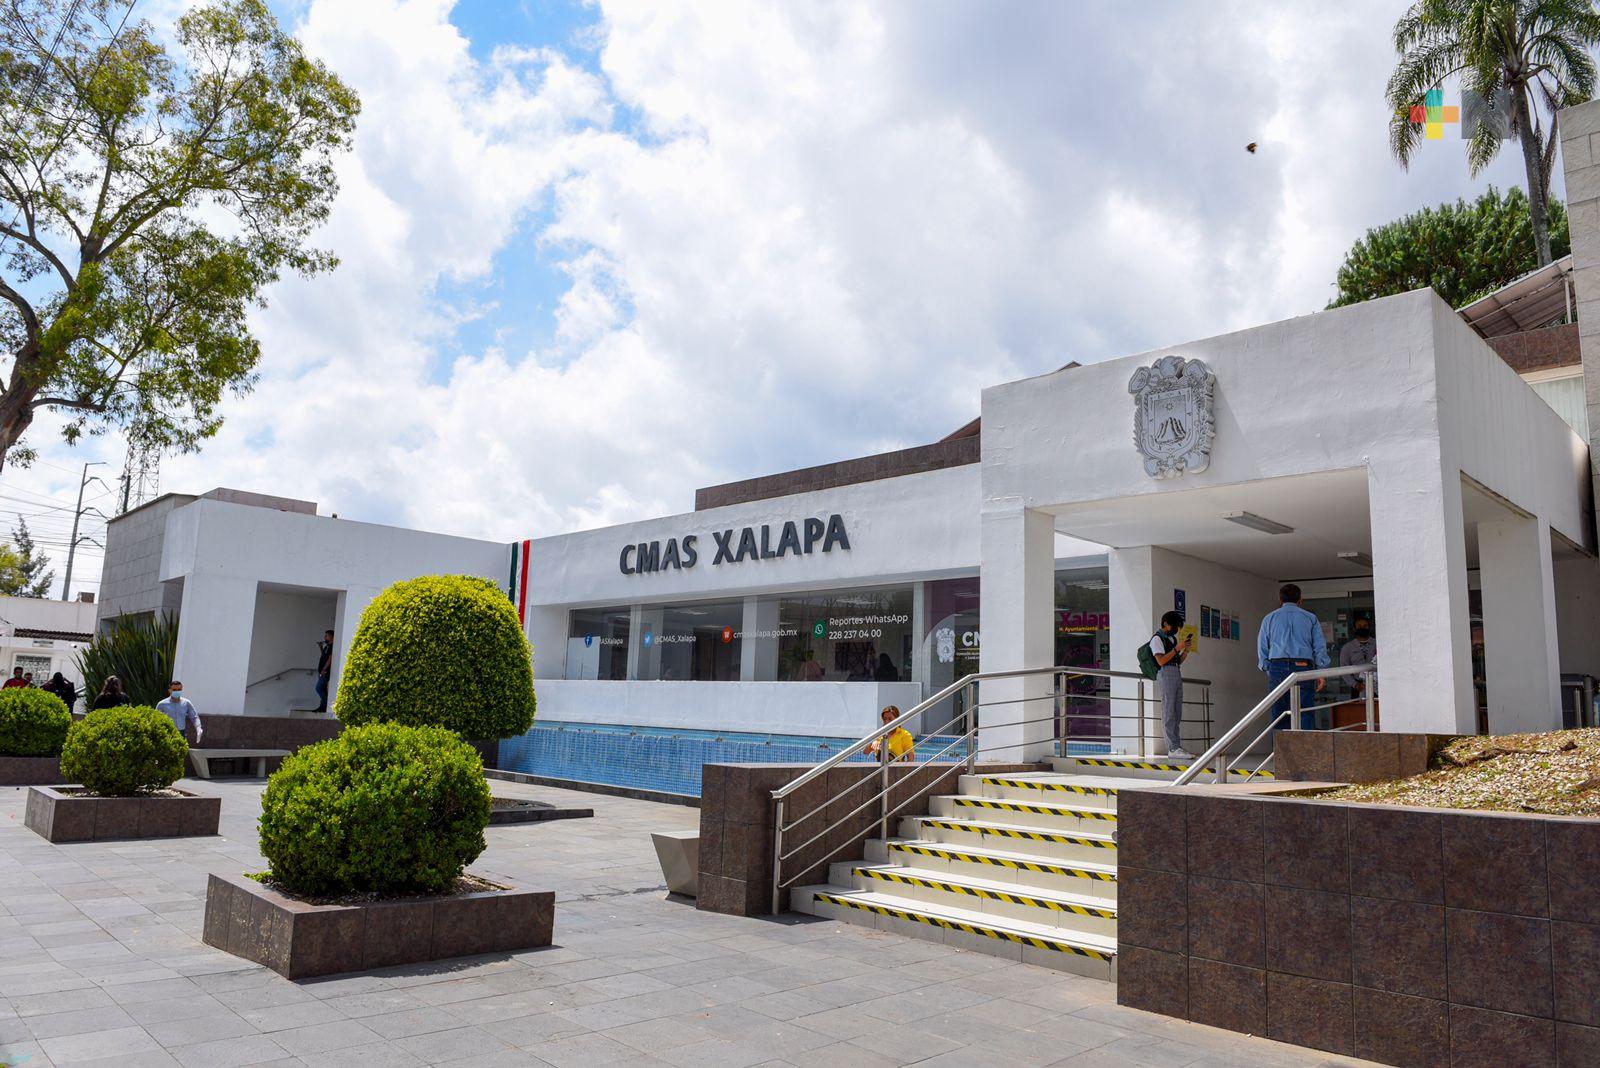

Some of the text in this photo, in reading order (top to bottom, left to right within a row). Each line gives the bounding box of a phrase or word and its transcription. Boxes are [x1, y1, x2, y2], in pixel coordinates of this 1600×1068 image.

[619, 514, 851, 575] CMAS XALAPA
[829, 614, 909, 627] Reportes WhatsApp
[828, 628, 882, 640] 228 237 04 00
